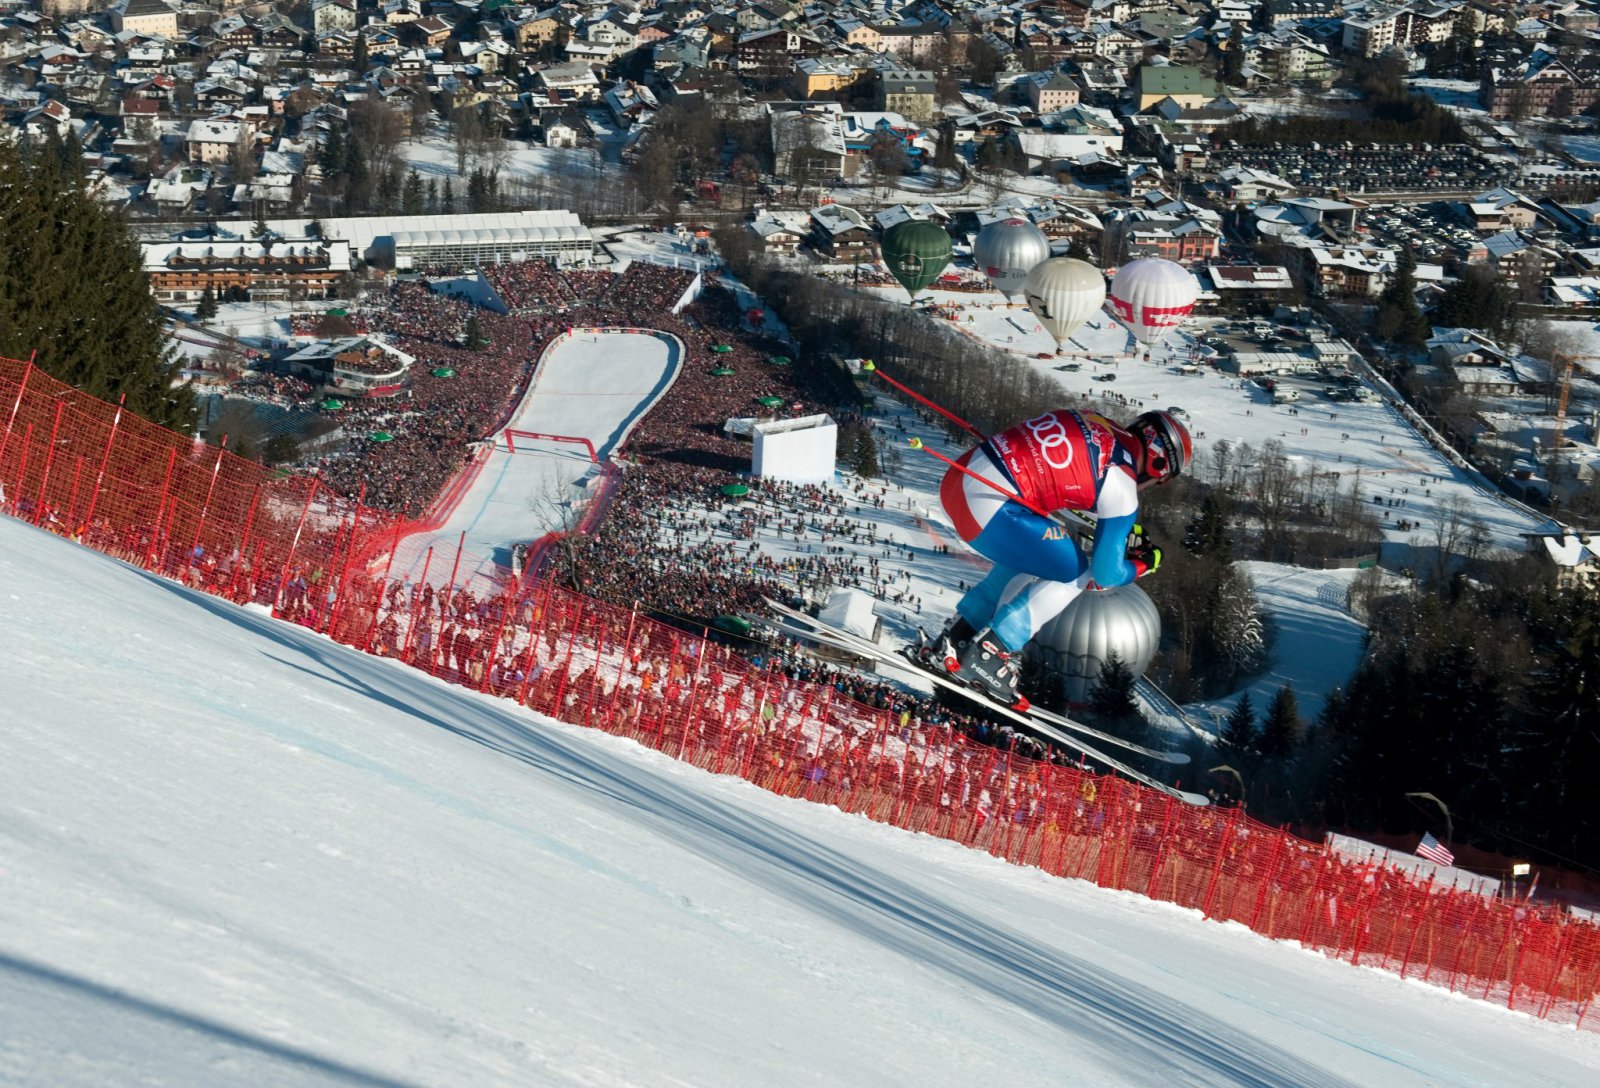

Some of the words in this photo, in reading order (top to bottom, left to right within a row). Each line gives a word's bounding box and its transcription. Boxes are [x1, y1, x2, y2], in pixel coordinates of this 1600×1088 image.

[1024, 435, 1038, 457] World
[1034, 457, 1046, 475] Cup
[970, 662, 1002, 689] HEAD
